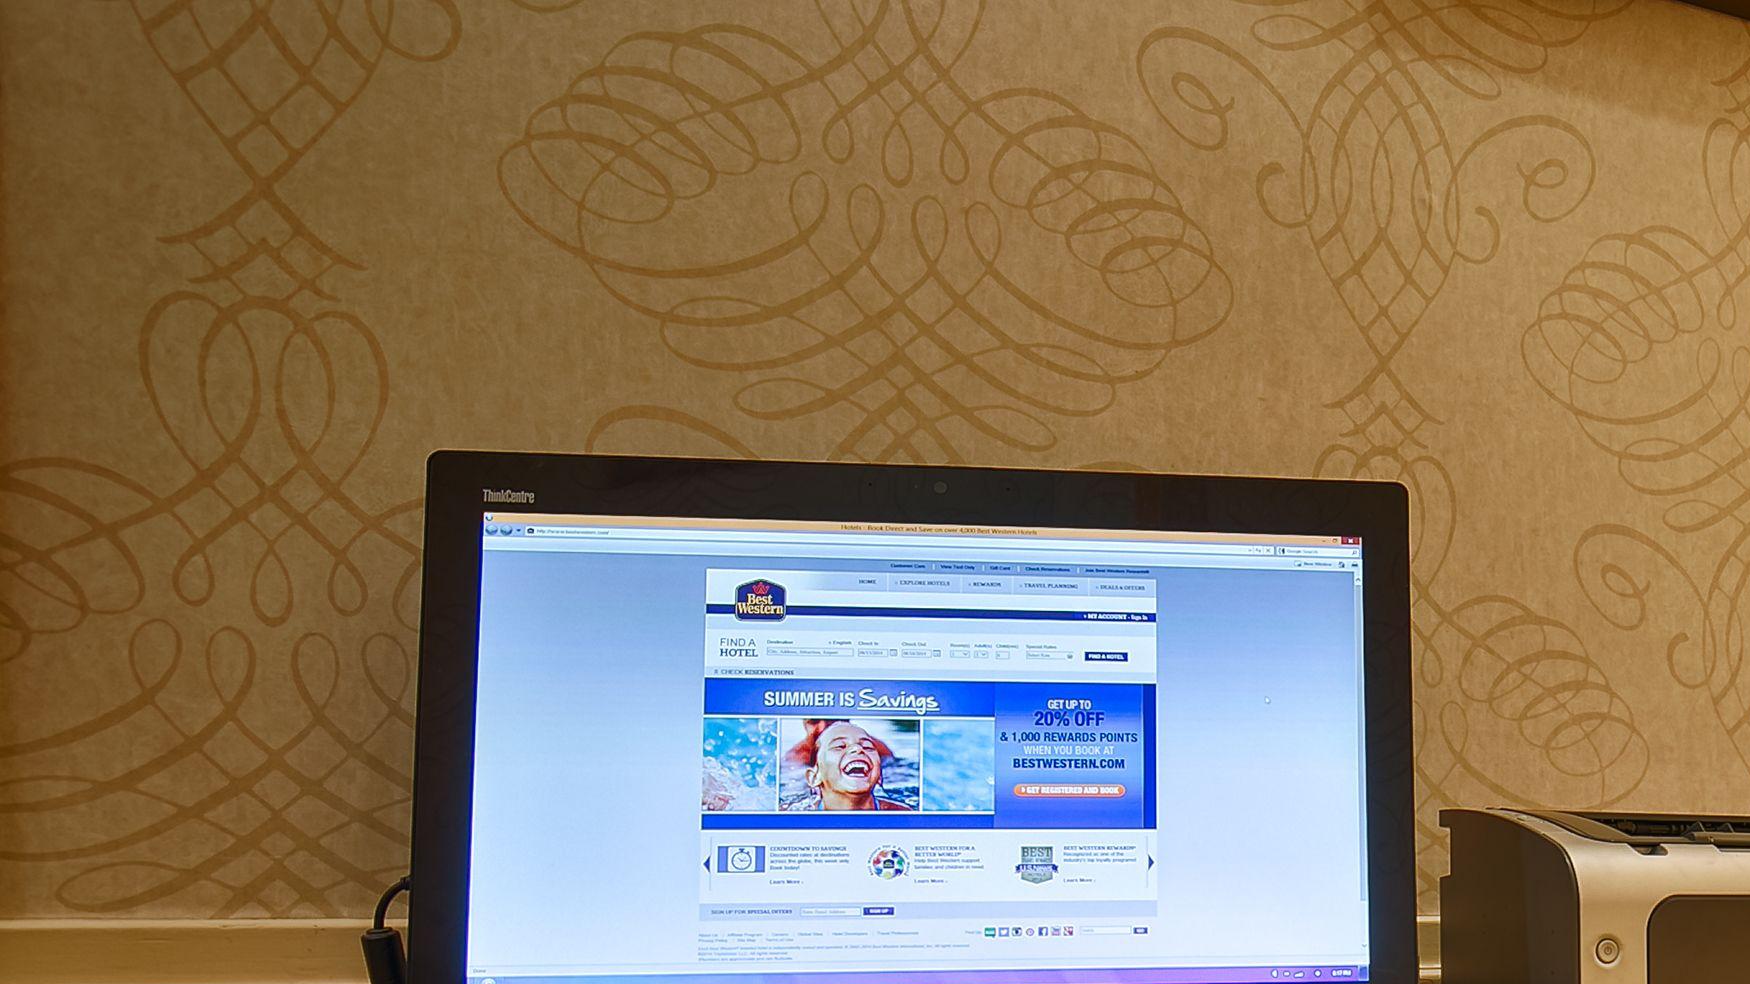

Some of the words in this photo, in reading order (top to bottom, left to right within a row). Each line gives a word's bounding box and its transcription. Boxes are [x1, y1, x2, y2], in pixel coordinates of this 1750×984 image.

[482, 489, 535, 504] ThinkCentre
[746, 594, 773, 605] Best
[737, 602, 784, 614] Western
[720, 637, 746, 647] FIND
[748, 637, 756, 647] A
[720, 648, 759, 657] HOTEL
[764, 691, 834, 707] SUMMER
[839, 691, 855, 707] IS
[857, 688, 940, 715] Savings
[1047, 699, 1065, 710] GET
[1066, 699, 1078, 710] UP
[1080, 699, 1092, 710] TO
[1034, 711, 1070, 726] 20%
[1074, 711, 1105, 726] OFF
[1000, 732, 1008, 743] &
[1012, 732, 1040, 744] 1,000
[1043, 732, 1096, 743] REWARDS
[1100, 732, 1138, 743] POINTS
[1023, 745, 1051, 755] WHEN
[1054, 745, 1073, 755] YOU
[1075, 745, 1100, 755] BOOK
[1103, 745, 1114, 755] AT
[1012, 758, 1125, 769] BESTWESTERN.COM
[1026, 786, 1040, 794] GET
[1041, 786, 1082, 794] REGISTERED
[1083, 786, 1098, 794] AND
[1100, 786, 1120, 794] BOOK
[1021, 847, 1051, 857] BEST
